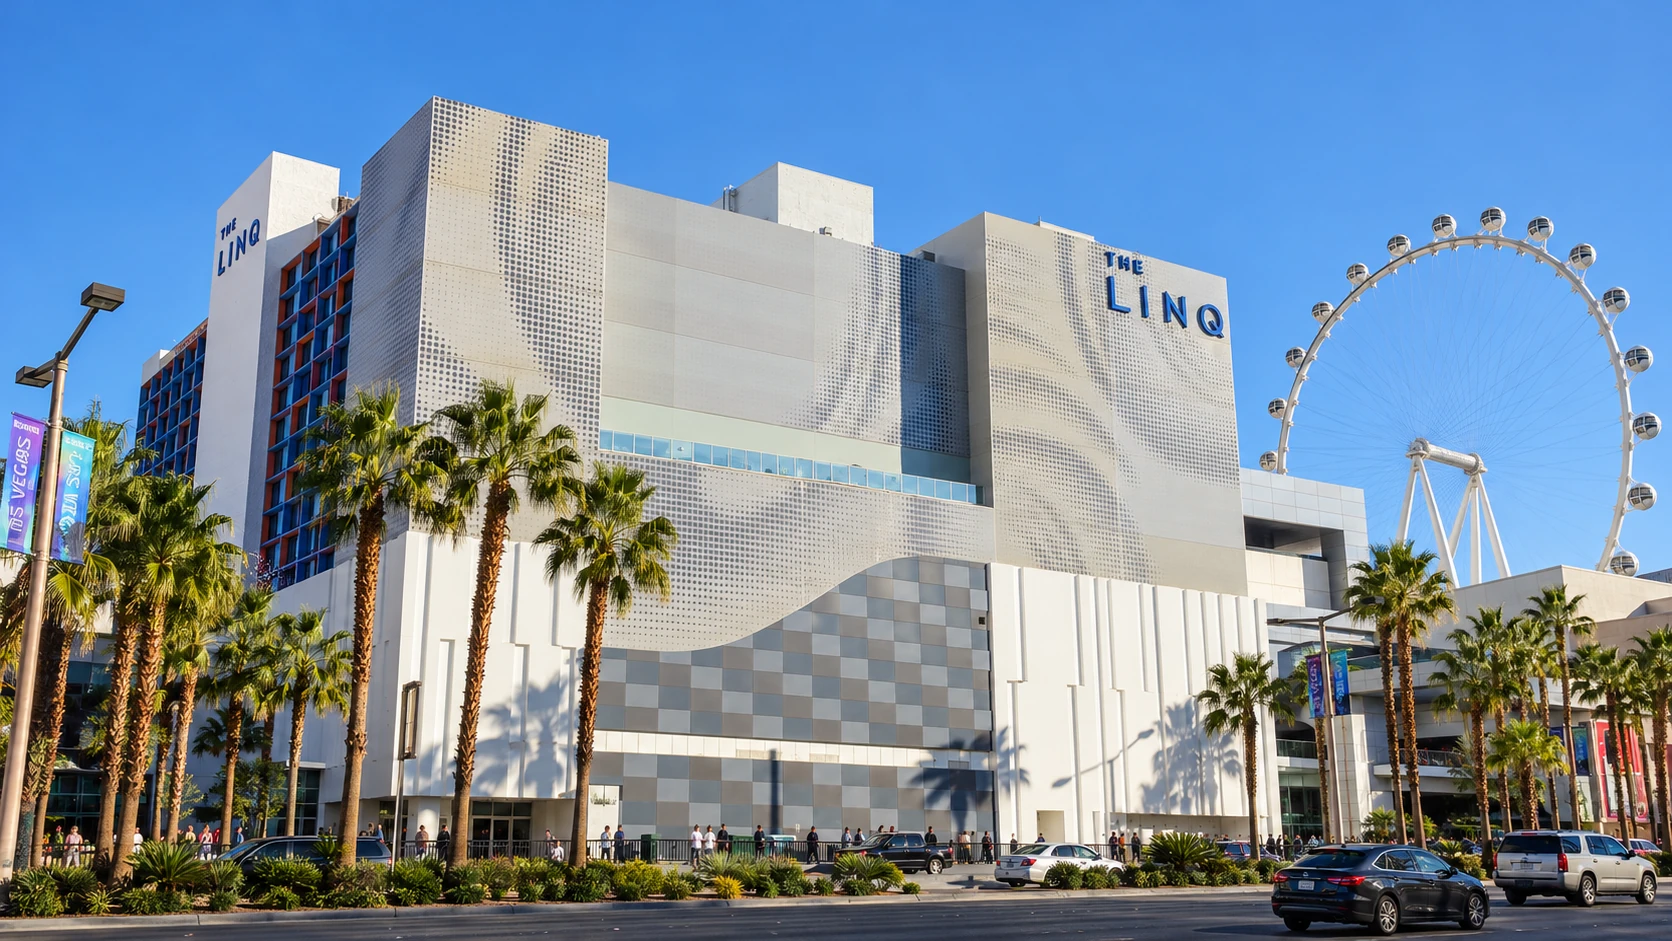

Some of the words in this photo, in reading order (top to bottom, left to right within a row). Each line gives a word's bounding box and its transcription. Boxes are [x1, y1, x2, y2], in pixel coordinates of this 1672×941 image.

[217, 218, 260, 277] LINQ
[220, 217, 237, 241] THE
[1104, 251, 1144, 275] THE
[1106, 275, 1224, 338] LINQ
